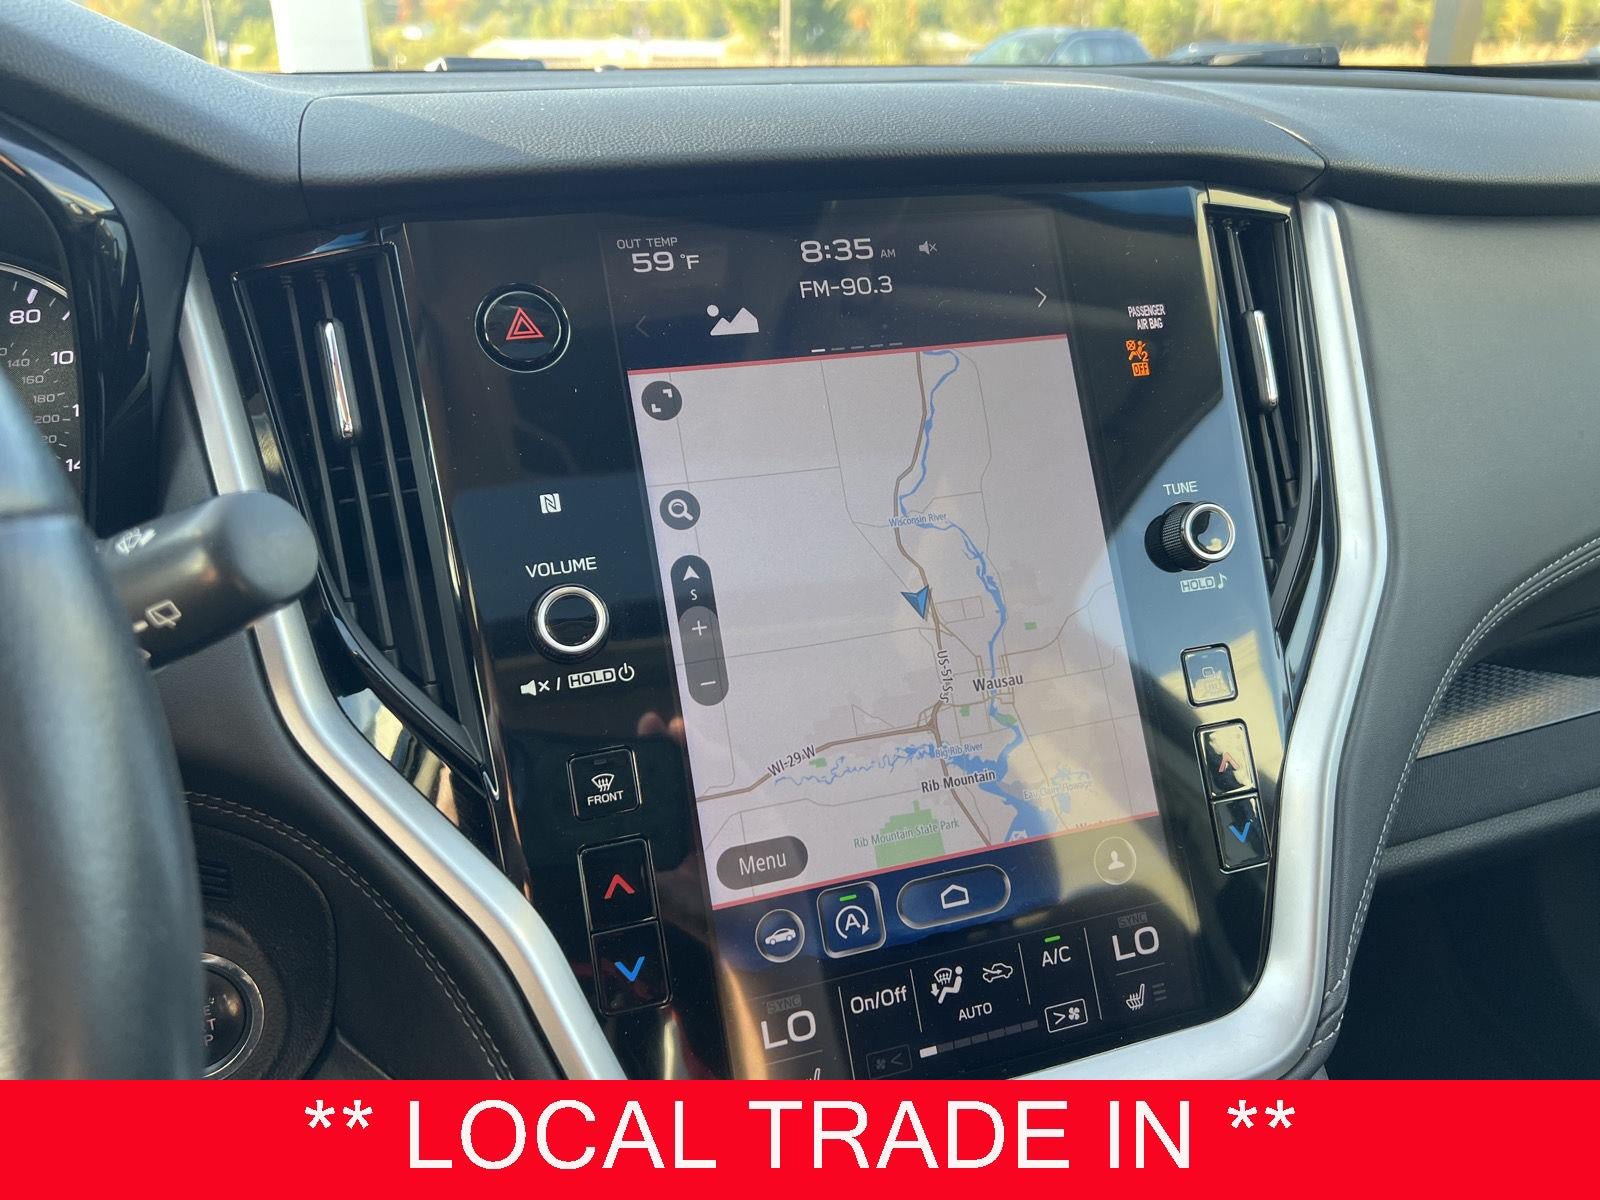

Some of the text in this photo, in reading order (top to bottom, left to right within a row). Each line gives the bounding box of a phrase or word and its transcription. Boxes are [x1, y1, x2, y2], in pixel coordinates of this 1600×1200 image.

[616, 237, 678, 249] OUT TEMP
[800, 237, 897, 263] 8:35 AM
[631, 251, 674, 273] 59
[799, 275, 893, 299] FM-90.3
[9, 308, 42, 324] 80
[1127, 304, 1166, 317] PASSENGER
[1136, 317, 1164, 330] AIR BAG
[1132, 363, 1149, 375] OFF
[1163, 481, 1198, 496] TUNE
[928, 512, 947, 522] River
[525, 557, 598, 578] VOLUME
[1181, 576, 1216, 592] HOLD
[568, 668, 617, 689] HOLD
[973, 674, 1024, 692] Wausau
[964, 743, 983, 753] River
[921, 769, 996, 793] Rib Mountain
[587, 790, 624, 806] FRONT
[854, 818, 960, 848] Rib Mountain State Park
[738, 853, 787, 876] Menu
[1112, 926, 1159, 961] LO
[1042, 945, 1071, 967] A/C
[850, 985, 908, 1014] On/Off
[958, 1002, 993, 1021] AUTO
[760, 1010, 816, 1050] LO
